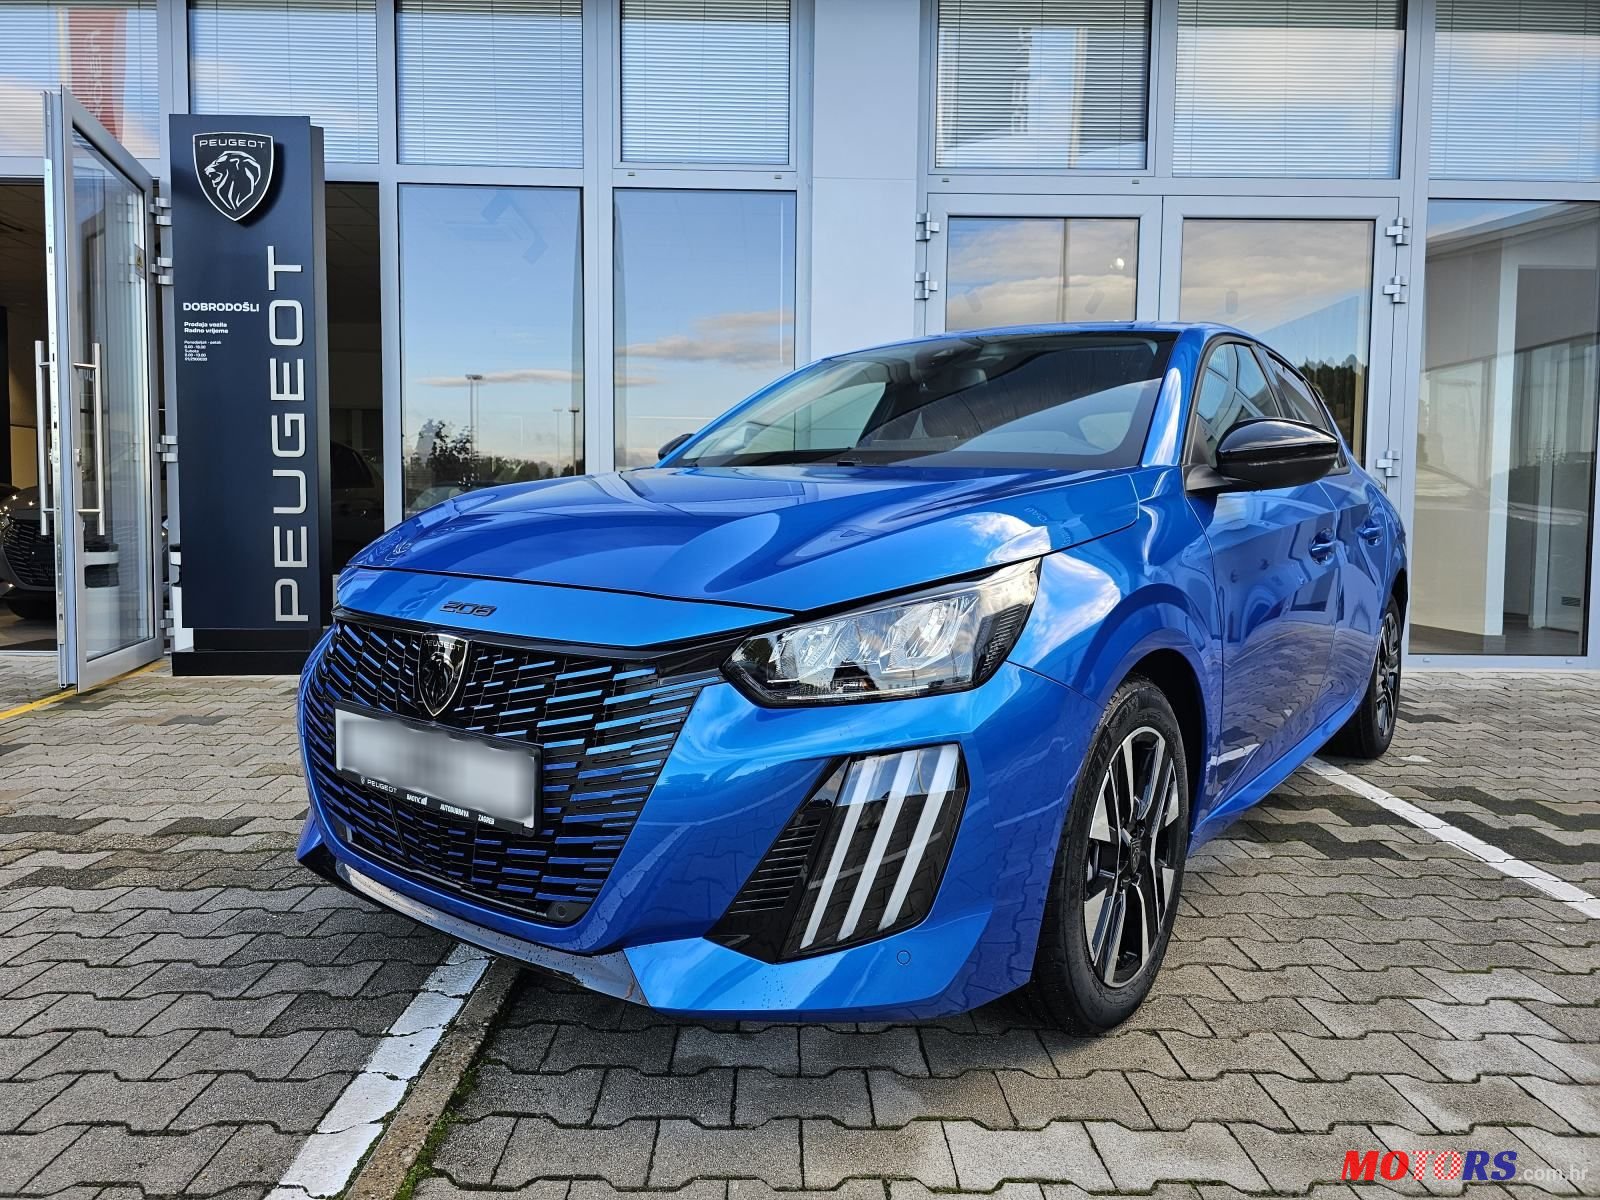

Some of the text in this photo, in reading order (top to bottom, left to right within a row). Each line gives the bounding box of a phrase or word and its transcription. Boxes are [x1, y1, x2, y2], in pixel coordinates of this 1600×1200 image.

[200, 139, 266, 148] PEUGEOT
[183, 302, 259, 311] DOBRODOŠLI
[267, 245, 309, 622] PEUGEOT
[440, 601, 497, 616] 208
[367, 779, 398, 793] PEUGEOT
